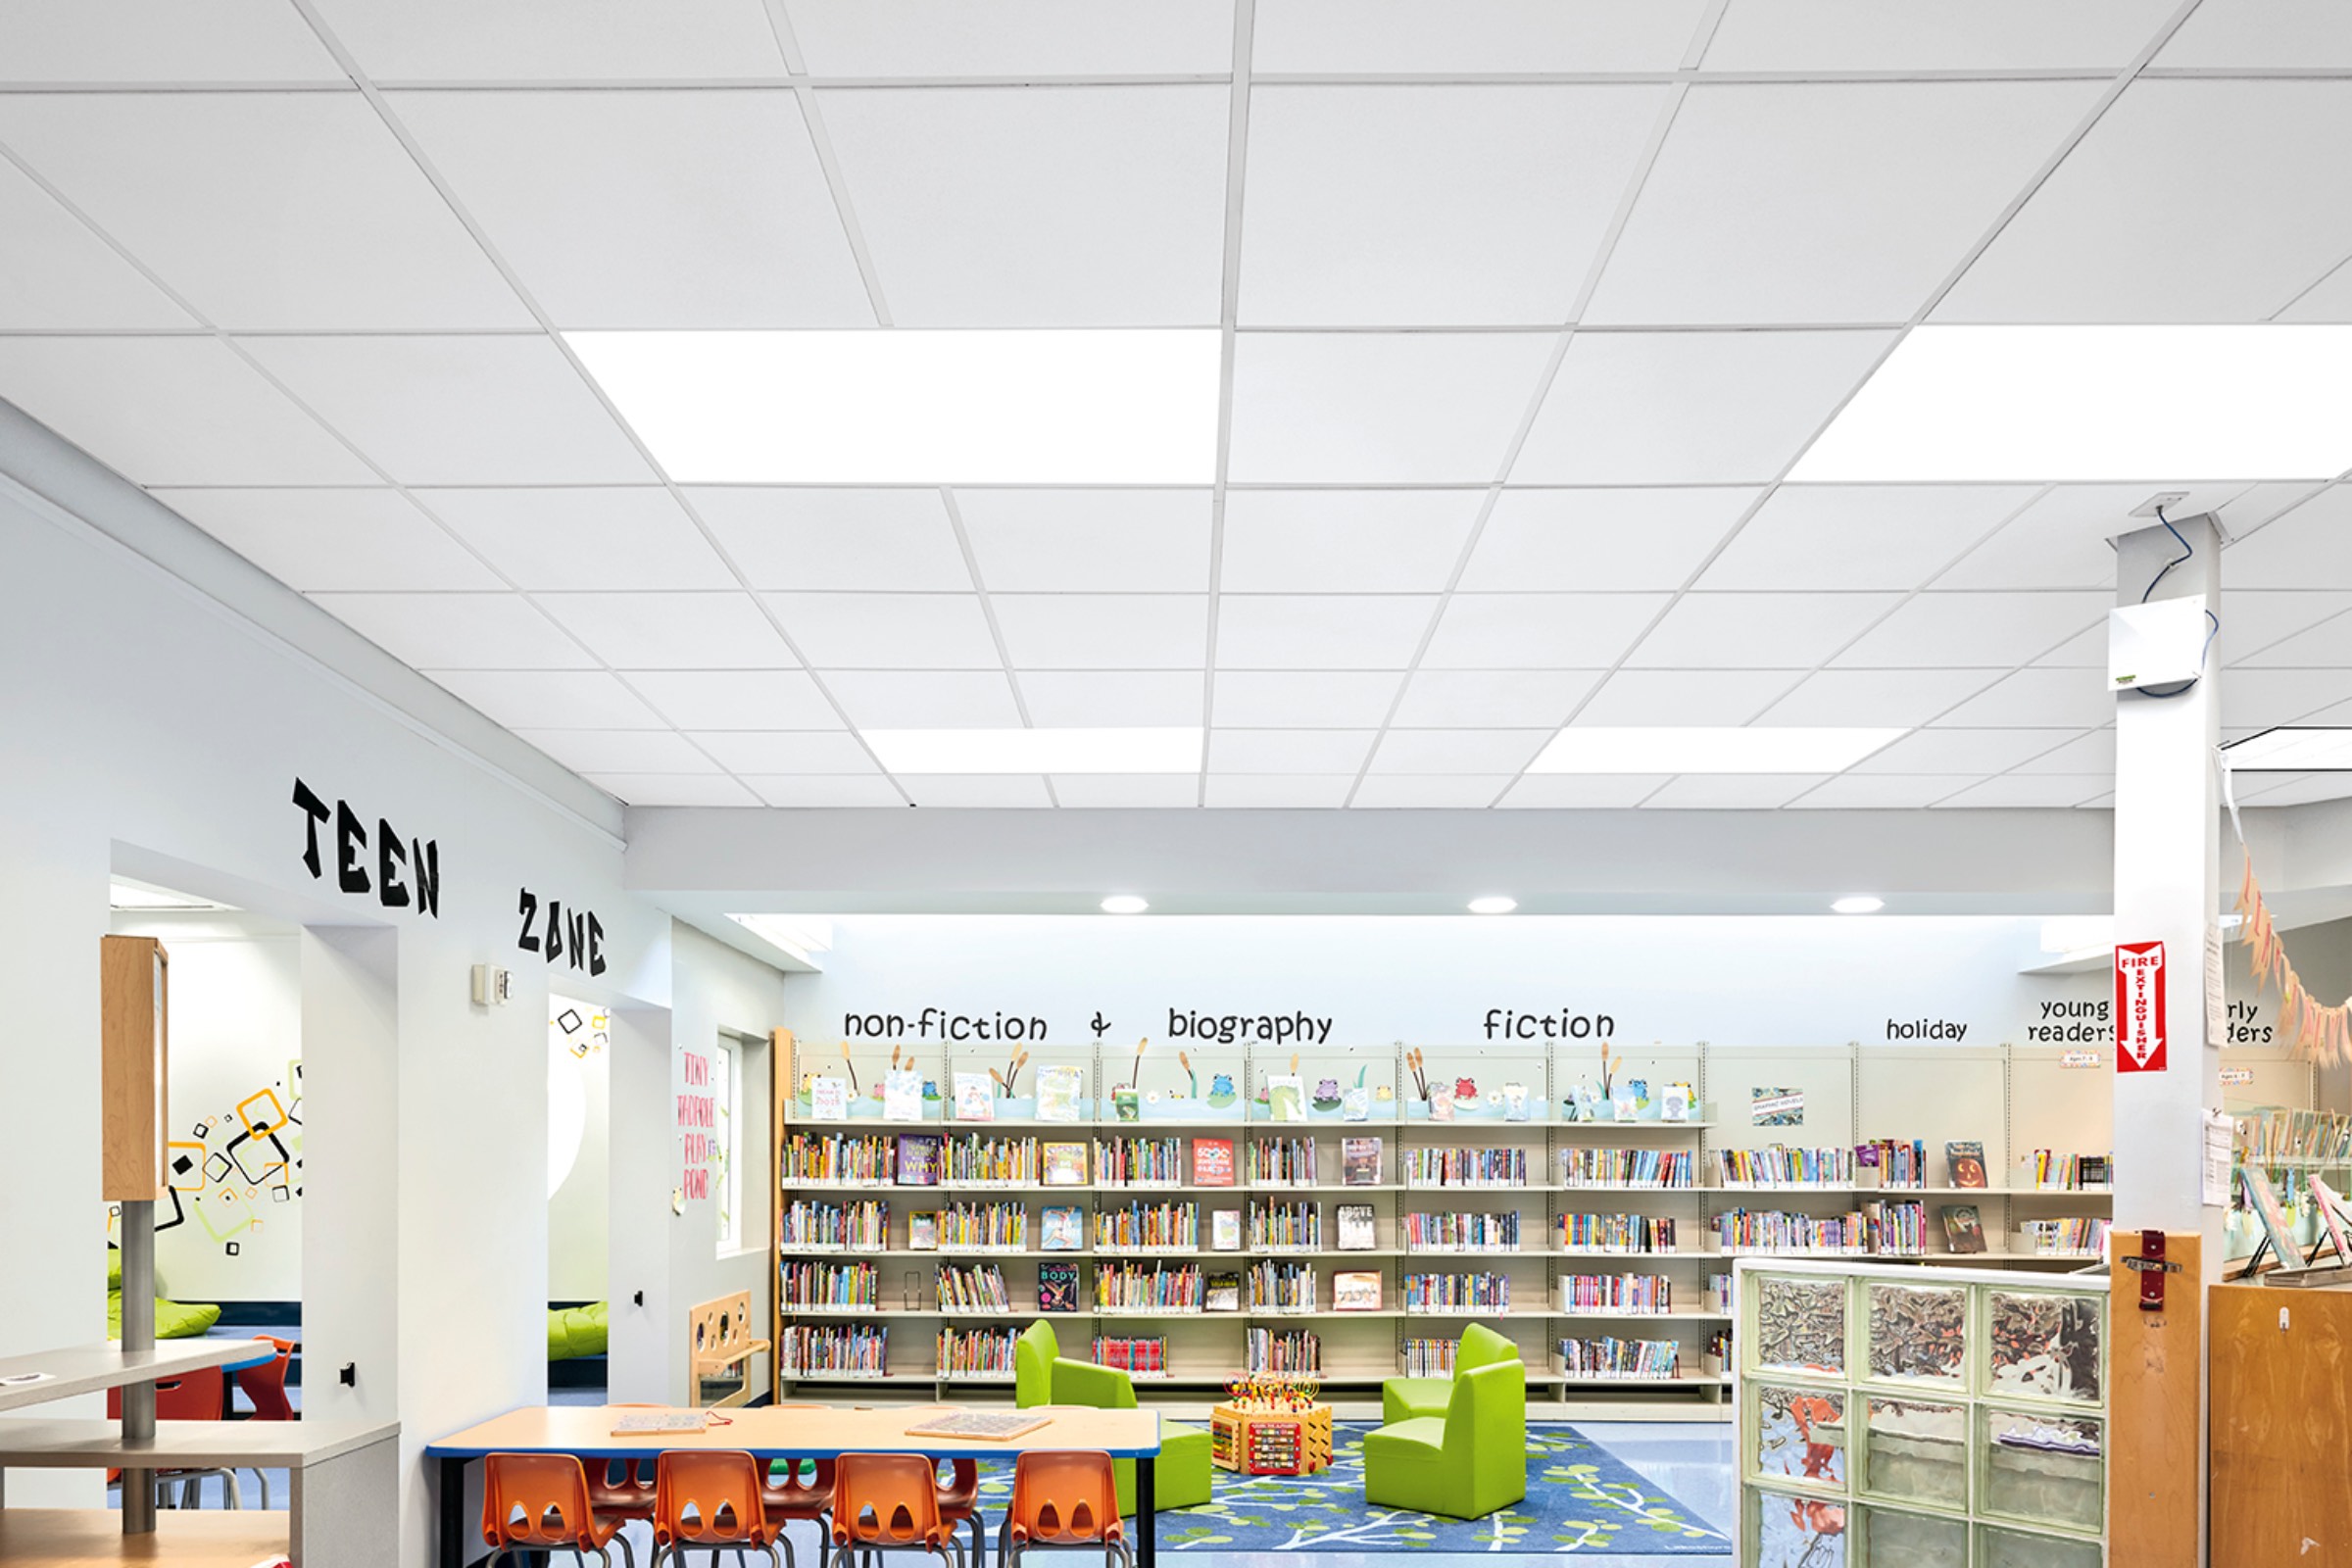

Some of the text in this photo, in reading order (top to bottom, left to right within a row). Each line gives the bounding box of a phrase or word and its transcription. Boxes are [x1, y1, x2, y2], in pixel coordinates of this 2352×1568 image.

[292, 777, 439, 919] TEEN
[518, 887, 607, 977] ZONE
[2121, 956, 2160, 969] FIRE
[845, 1007, 1111, 1041] non-fiction &
[1168, 1007, 1333, 1045] biography
[1484, 1007, 1614, 1040] fiction
[2040, 1001, 2109, 1021] young
[2134, 968, 2148, 1059] EXTINGUISHER
[1886, 1018, 1967, 1042] holiday
[684, 1052, 709, 1086] TINY
[677, 1095, 714, 1127] TADPOLE
[684, 1133, 707, 1164] PLAY
[683, 1168, 709, 1200] POND
[1041, 1271, 1076, 1281] BODY
